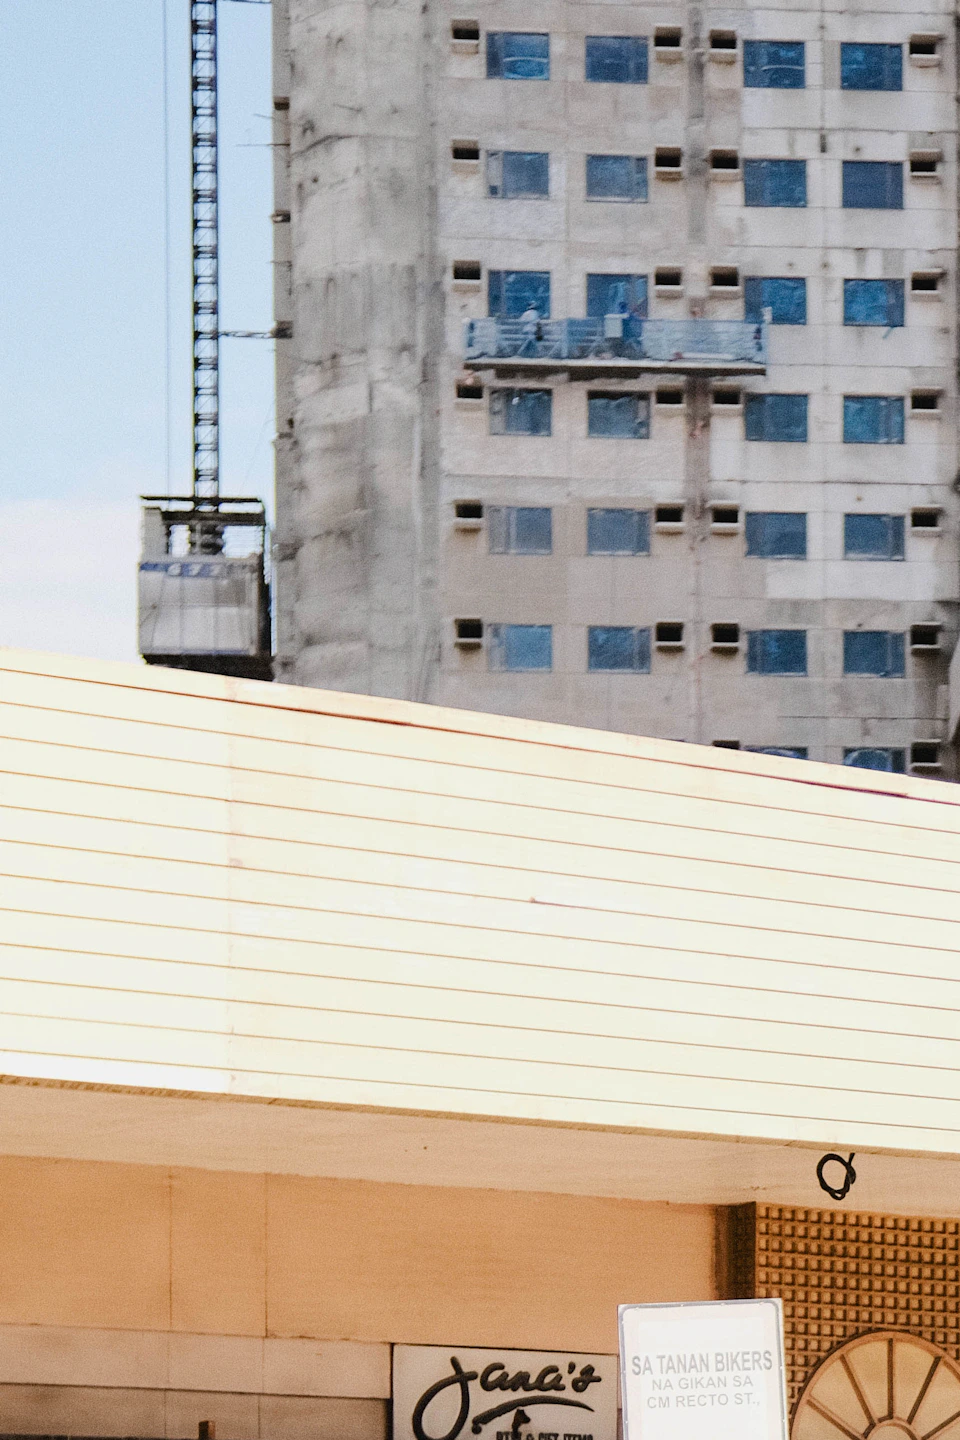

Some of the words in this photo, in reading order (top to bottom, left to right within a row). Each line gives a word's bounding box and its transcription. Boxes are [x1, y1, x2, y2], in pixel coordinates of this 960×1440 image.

[631, 1355, 653, 1376] SA
[656, 1352, 710, 1374] TANAN
[714, 1350, 773, 1373] BIKERS
[651, 1378, 674, 1391] NA
[678, 1376, 728, 1390] GIKAN
[732, 1375, 754, 1387] SA
[647, 1396, 670, 1409] CM
[675, 1393, 729, 1408] RECTO
